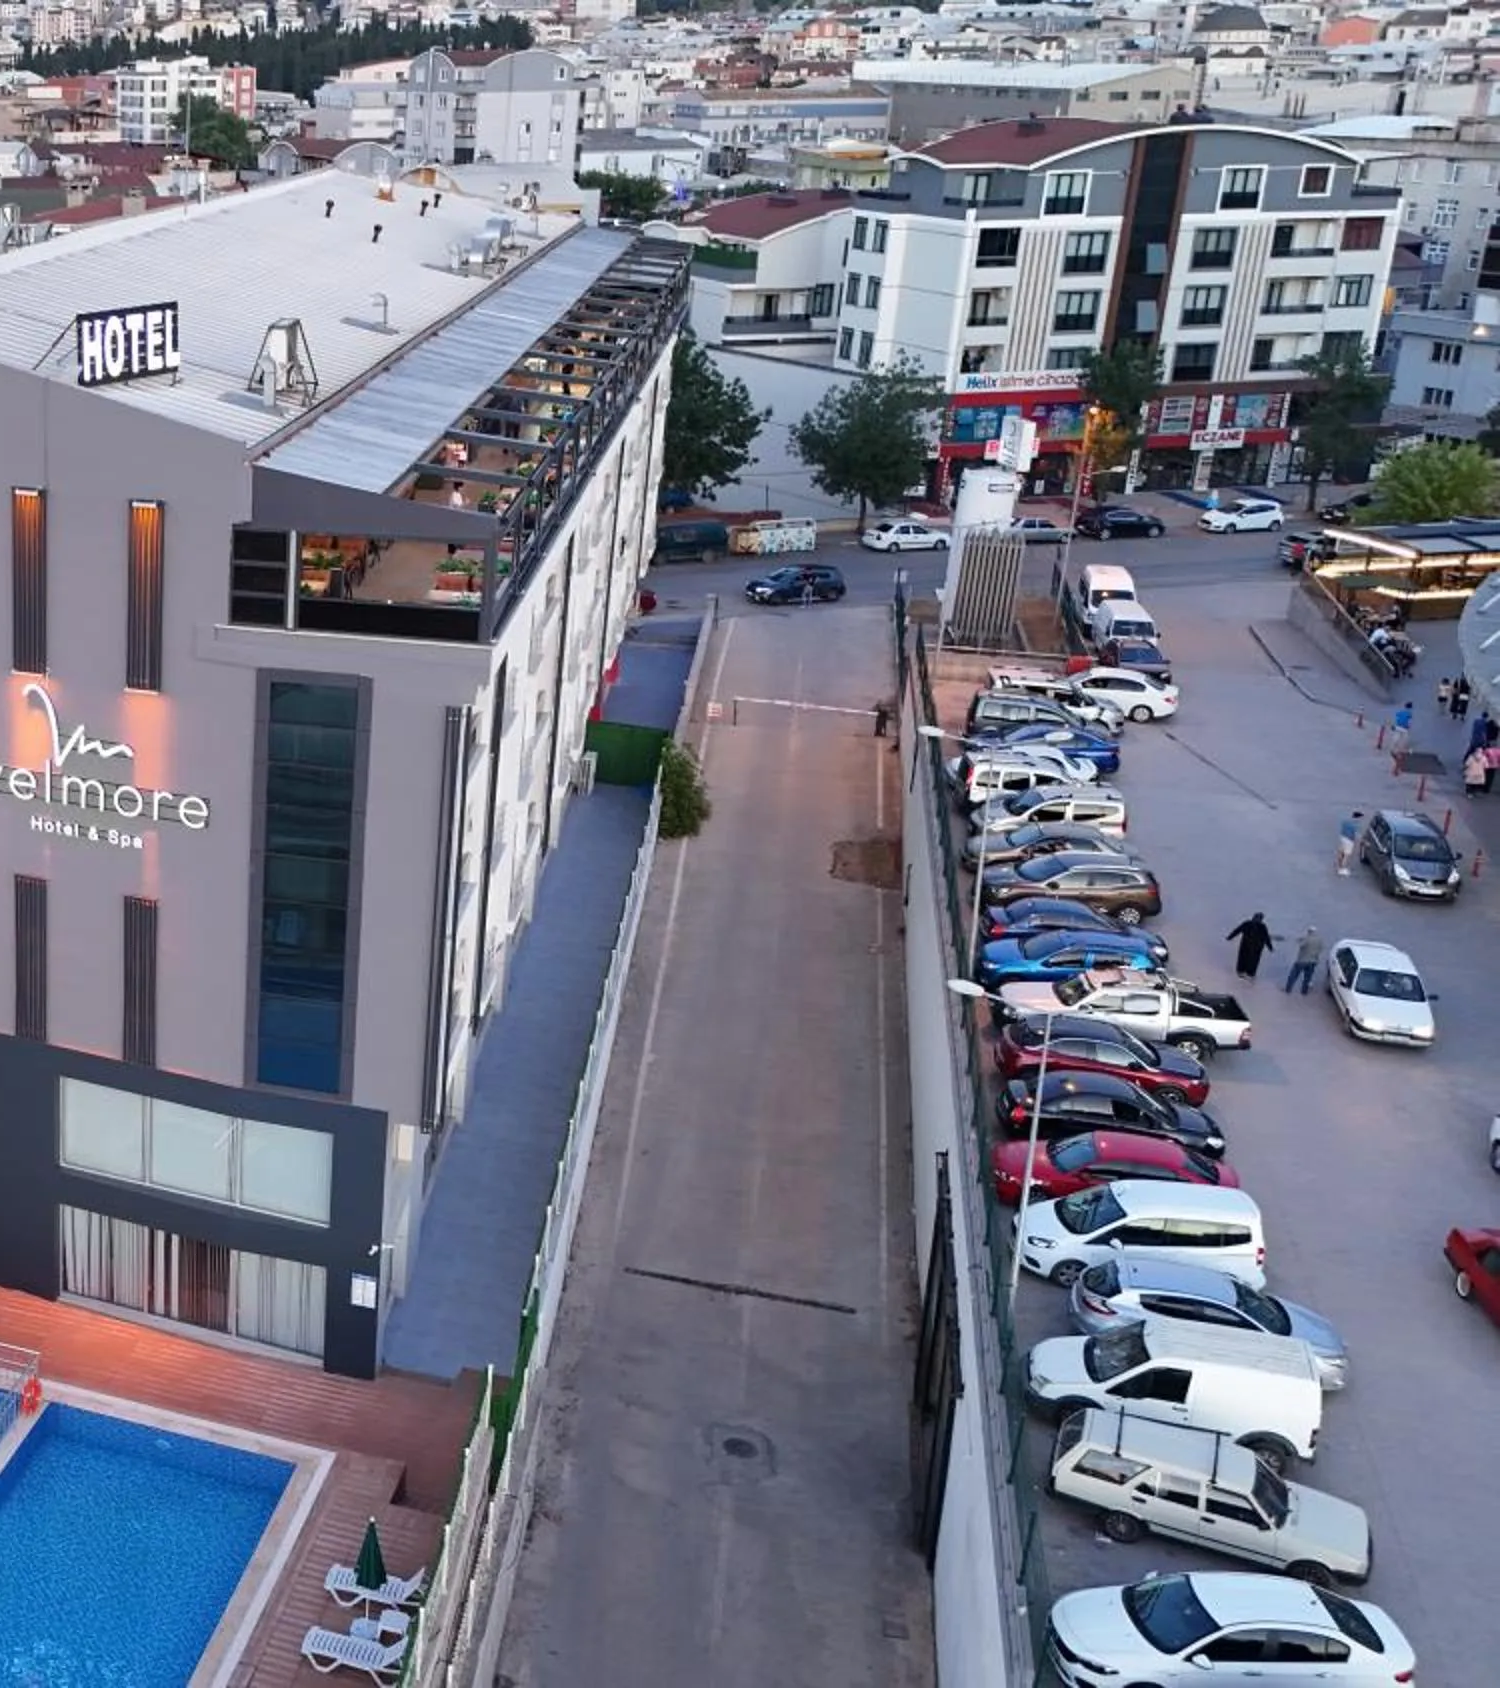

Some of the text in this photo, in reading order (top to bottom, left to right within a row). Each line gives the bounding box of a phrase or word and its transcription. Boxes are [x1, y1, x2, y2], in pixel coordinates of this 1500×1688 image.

[81, 308, 181, 383] HOTEL
[1195, 431, 1241, 443] ECZANE
[30, 815, 144, 850] Hotel & Spa
